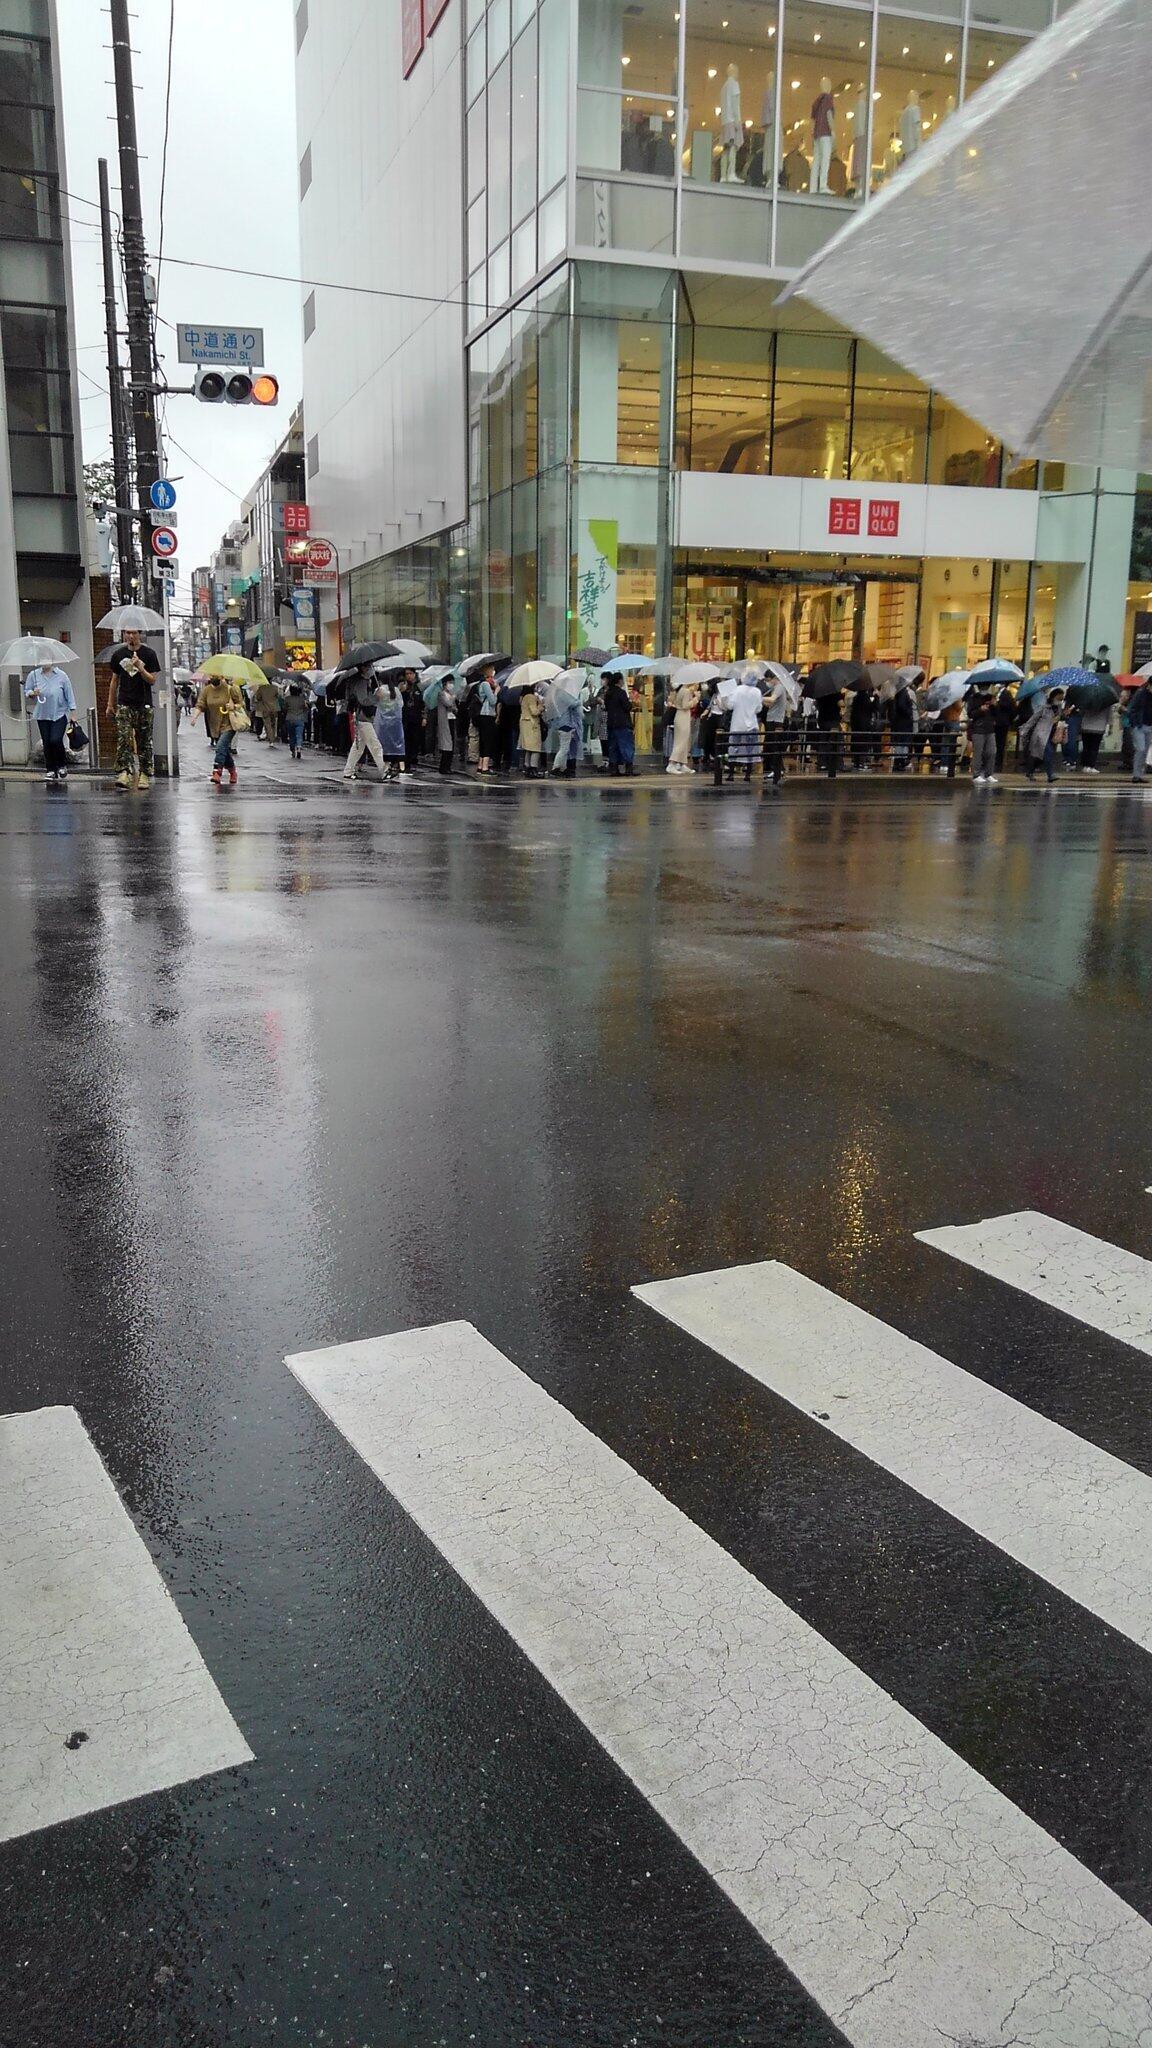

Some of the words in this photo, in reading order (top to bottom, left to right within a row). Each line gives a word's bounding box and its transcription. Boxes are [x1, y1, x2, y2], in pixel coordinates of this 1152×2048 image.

[184, 329, 256, 350] 中道通り
[191, 348, 237, 360] Nakamichi
[239, 350, 251, 361] St.
[287, 506, 306, 517] ユニ
[834, 502, 856, 516] ユニ
[871, 504, 894, 518] UNI
[287, 518, 306, 527] クロ
[832, 517, 857, 530] クロ
[871, 519, 896, 533] QLO
[310, 549, 331, 560] 消火栓
[691, 631, 720, 656] UT
